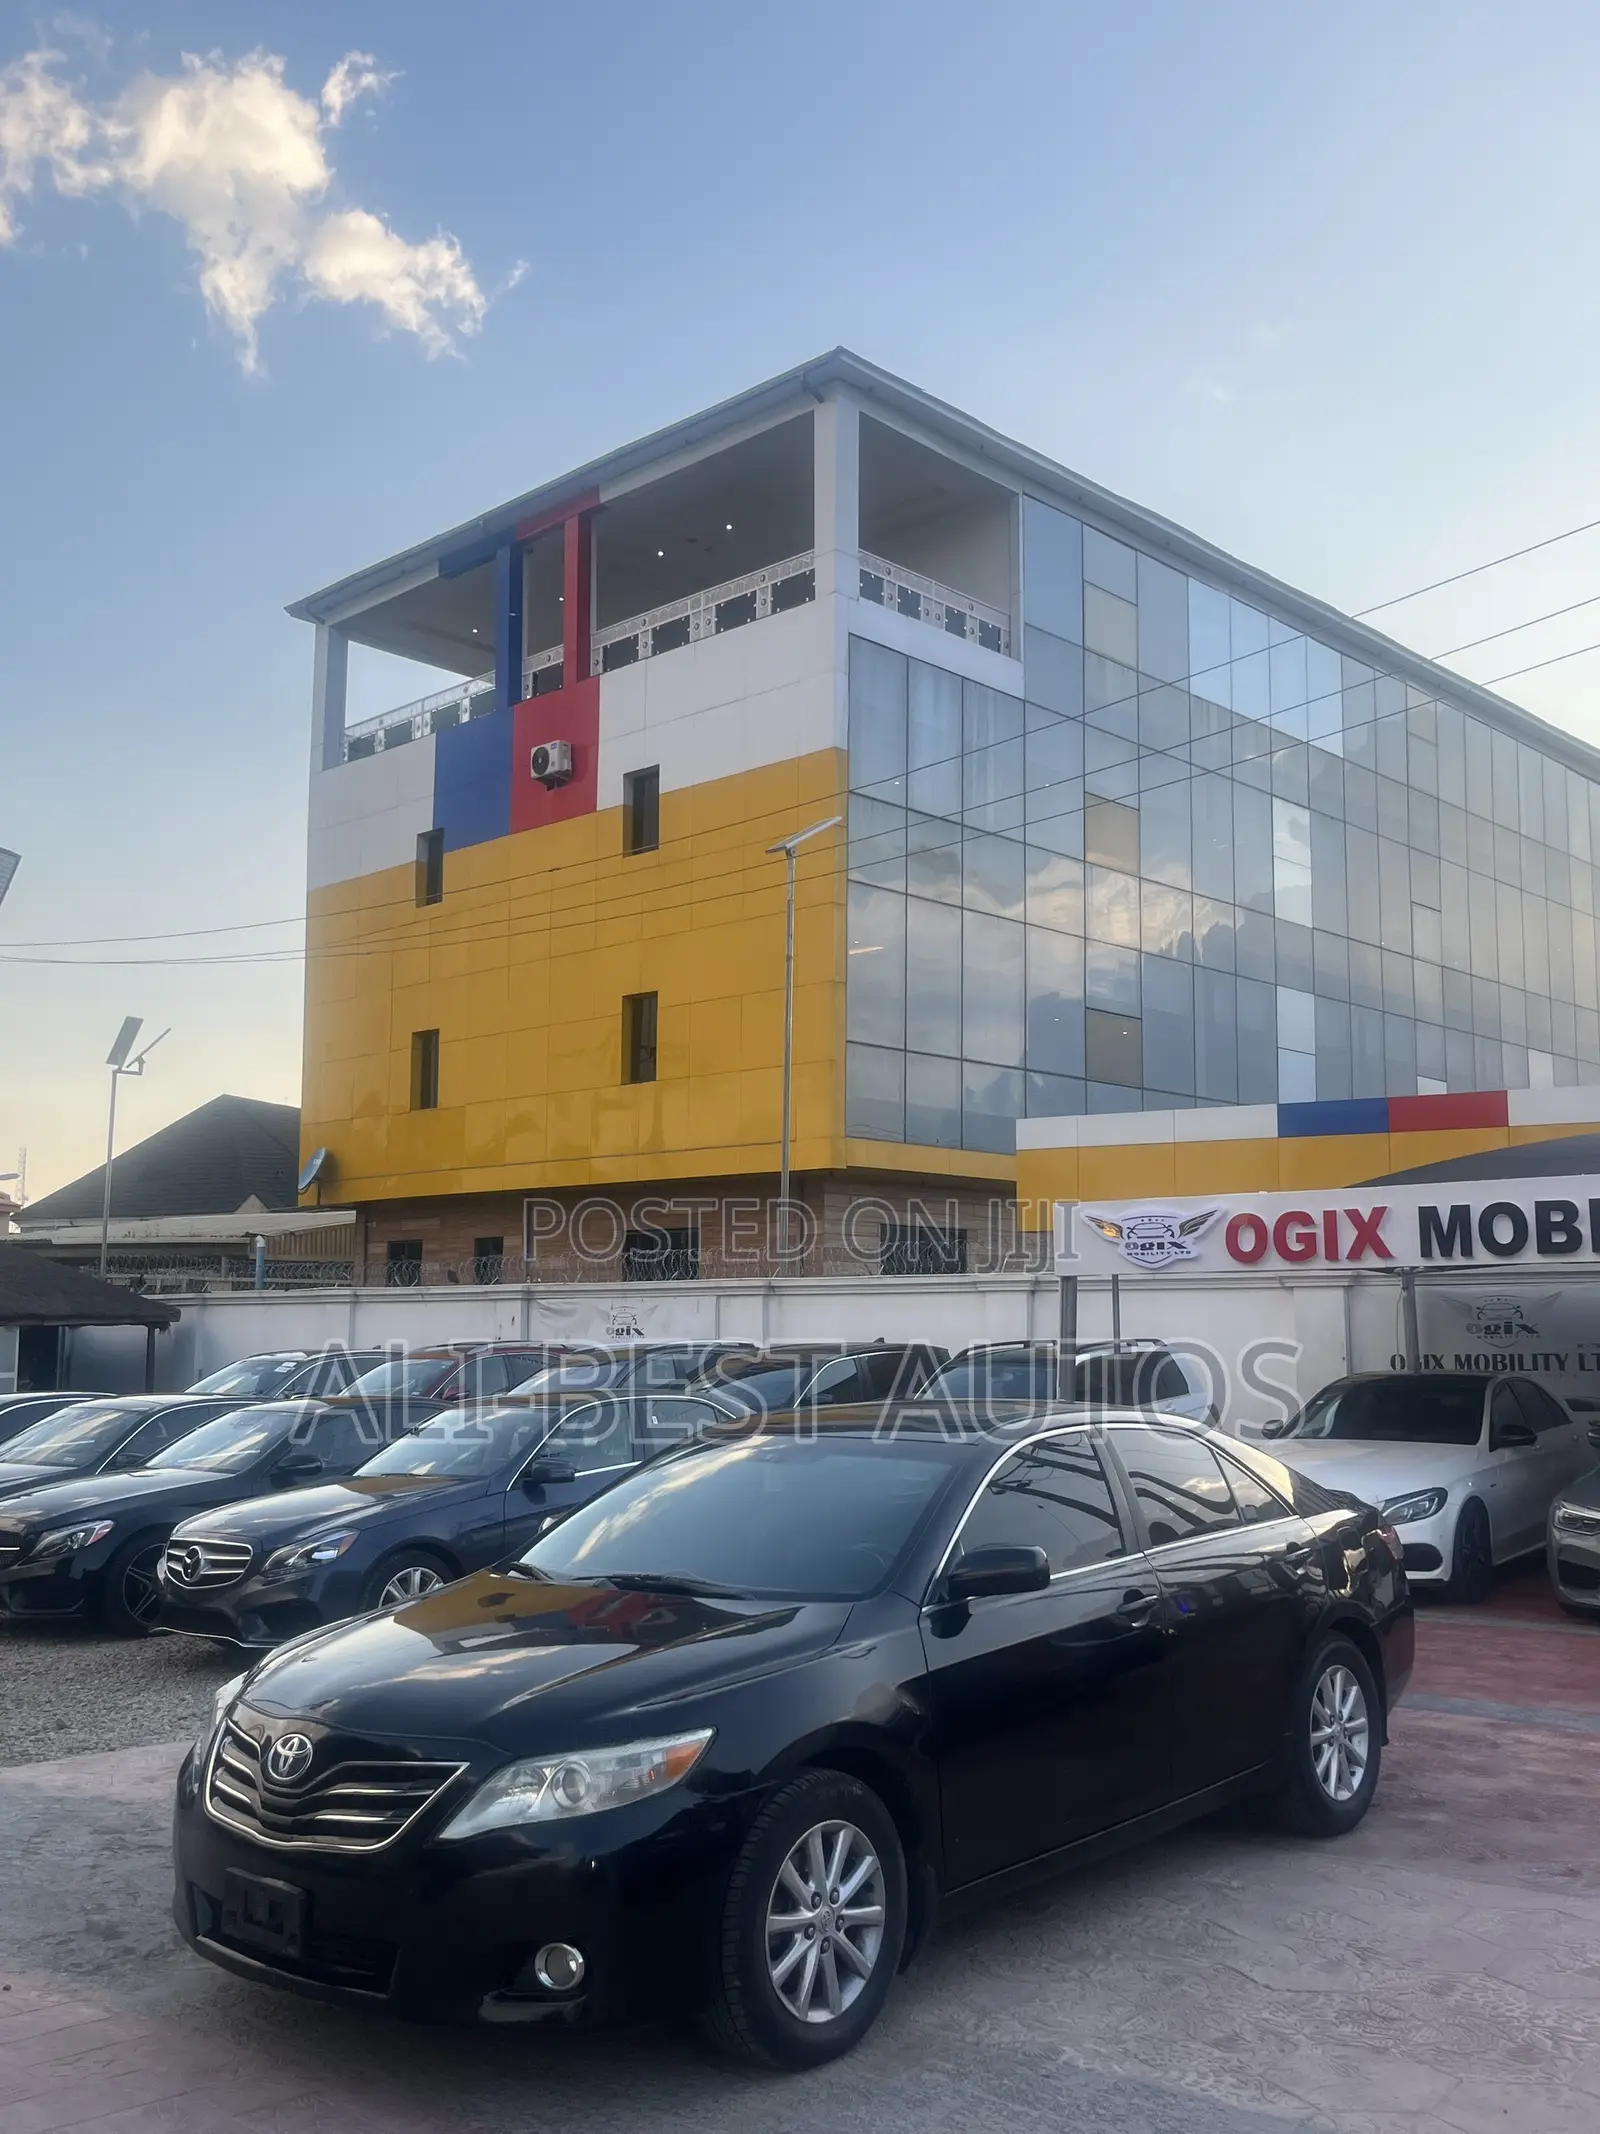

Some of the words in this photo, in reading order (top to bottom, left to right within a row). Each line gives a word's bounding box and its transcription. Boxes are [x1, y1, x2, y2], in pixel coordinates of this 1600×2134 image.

[1224, 1205, 1396, 1264] OGIX
[1390, 1353, 1444, 1371] OIX
[1454, 1353, 1568, 1371] MOBILITY
